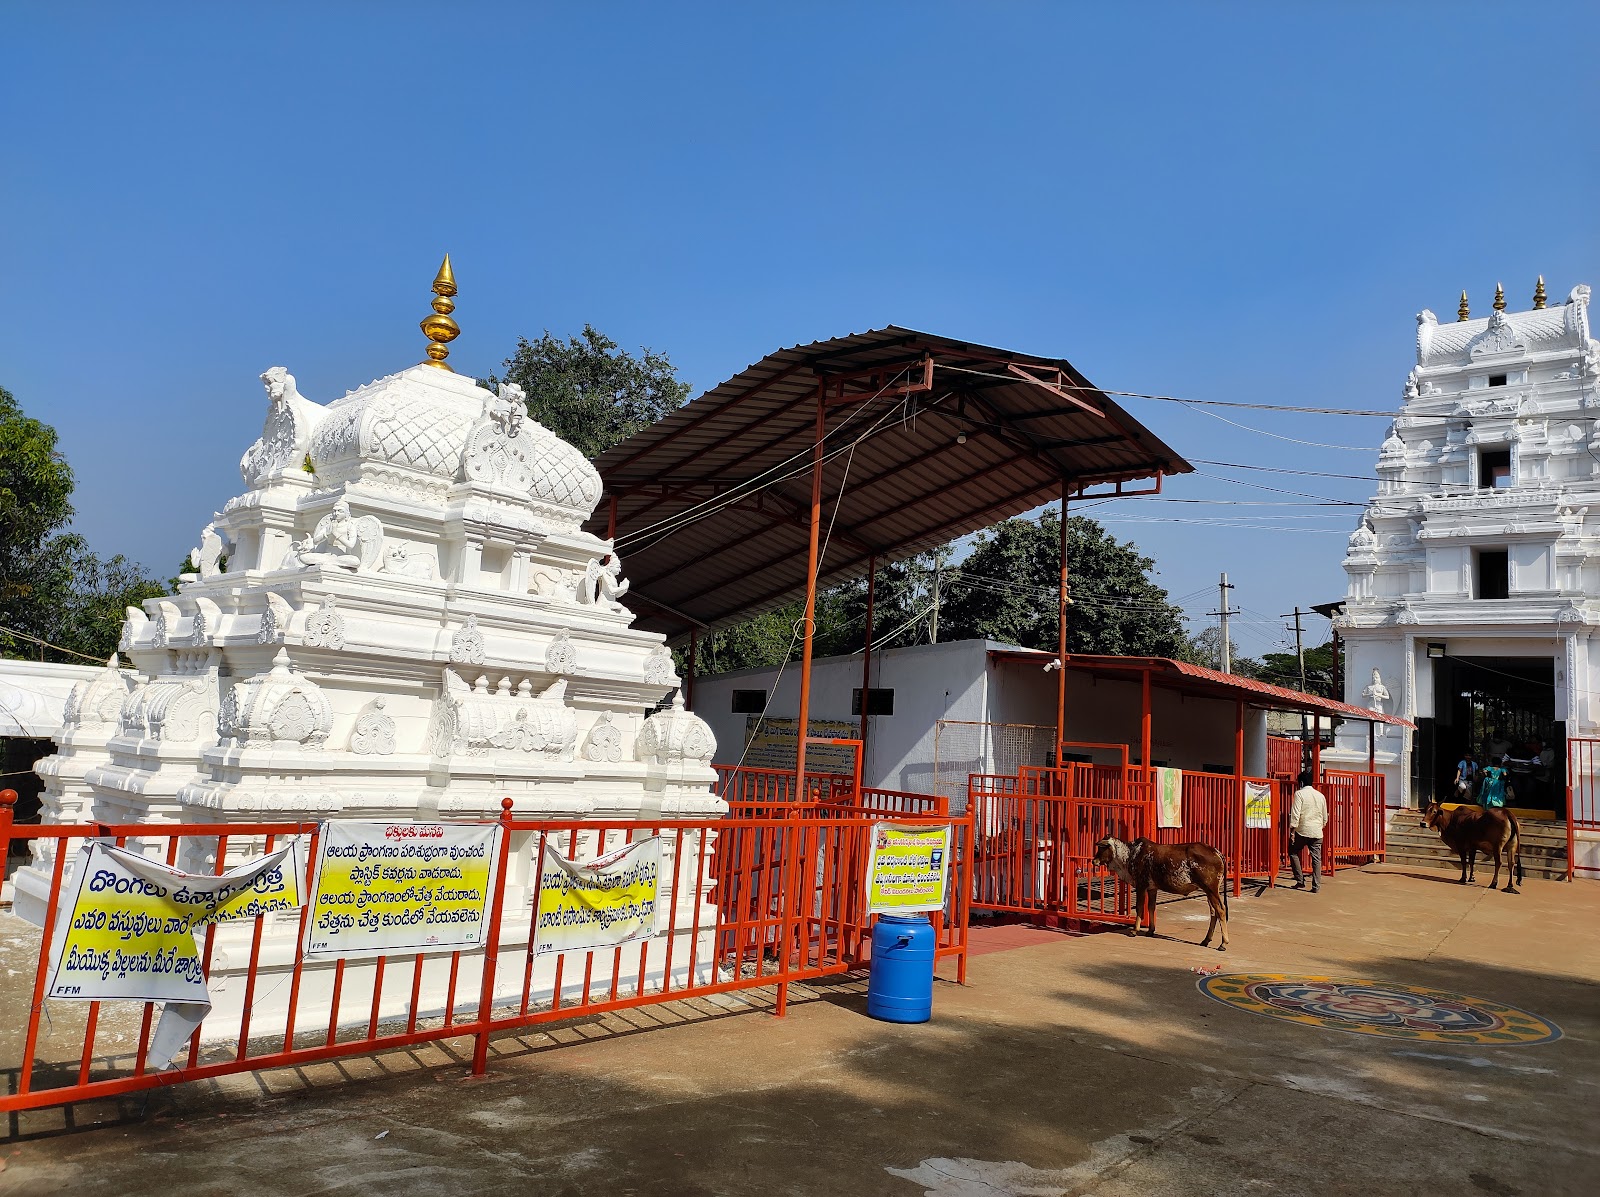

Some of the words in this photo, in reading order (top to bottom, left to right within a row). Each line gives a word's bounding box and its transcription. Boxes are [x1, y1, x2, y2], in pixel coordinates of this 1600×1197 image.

[419, 826, 444, 838] మనవి
[326, 844, 358, 858] ఆలయ
[357, 843, 400, 862] ప్రాంగణం
[449, 842, 485, 862] వుంచండి
[89, 868, 168, 898] దొంగలు
[350, 863, 382, 887] ప్లాస్టిక్
[381, 866, 418, 884] కవర్లను
[319, 891, 356, 905] ఆలయ
[73, 908, 107, 931] ఎవరి
[108, 910, 163, 940] వస్తువులు
[163, 913, 193, 936] వారే
[381, 907, 424, 927] కుండిలో
[425, 906, 480, 925] వేయవలెను
[66, 944, 111, 981] మీయొక్క
[111, 948, 152, 979] పిల్లలను
[151, 945, 178, 974] మీరే
[56, 985, 82, 995] FFM
